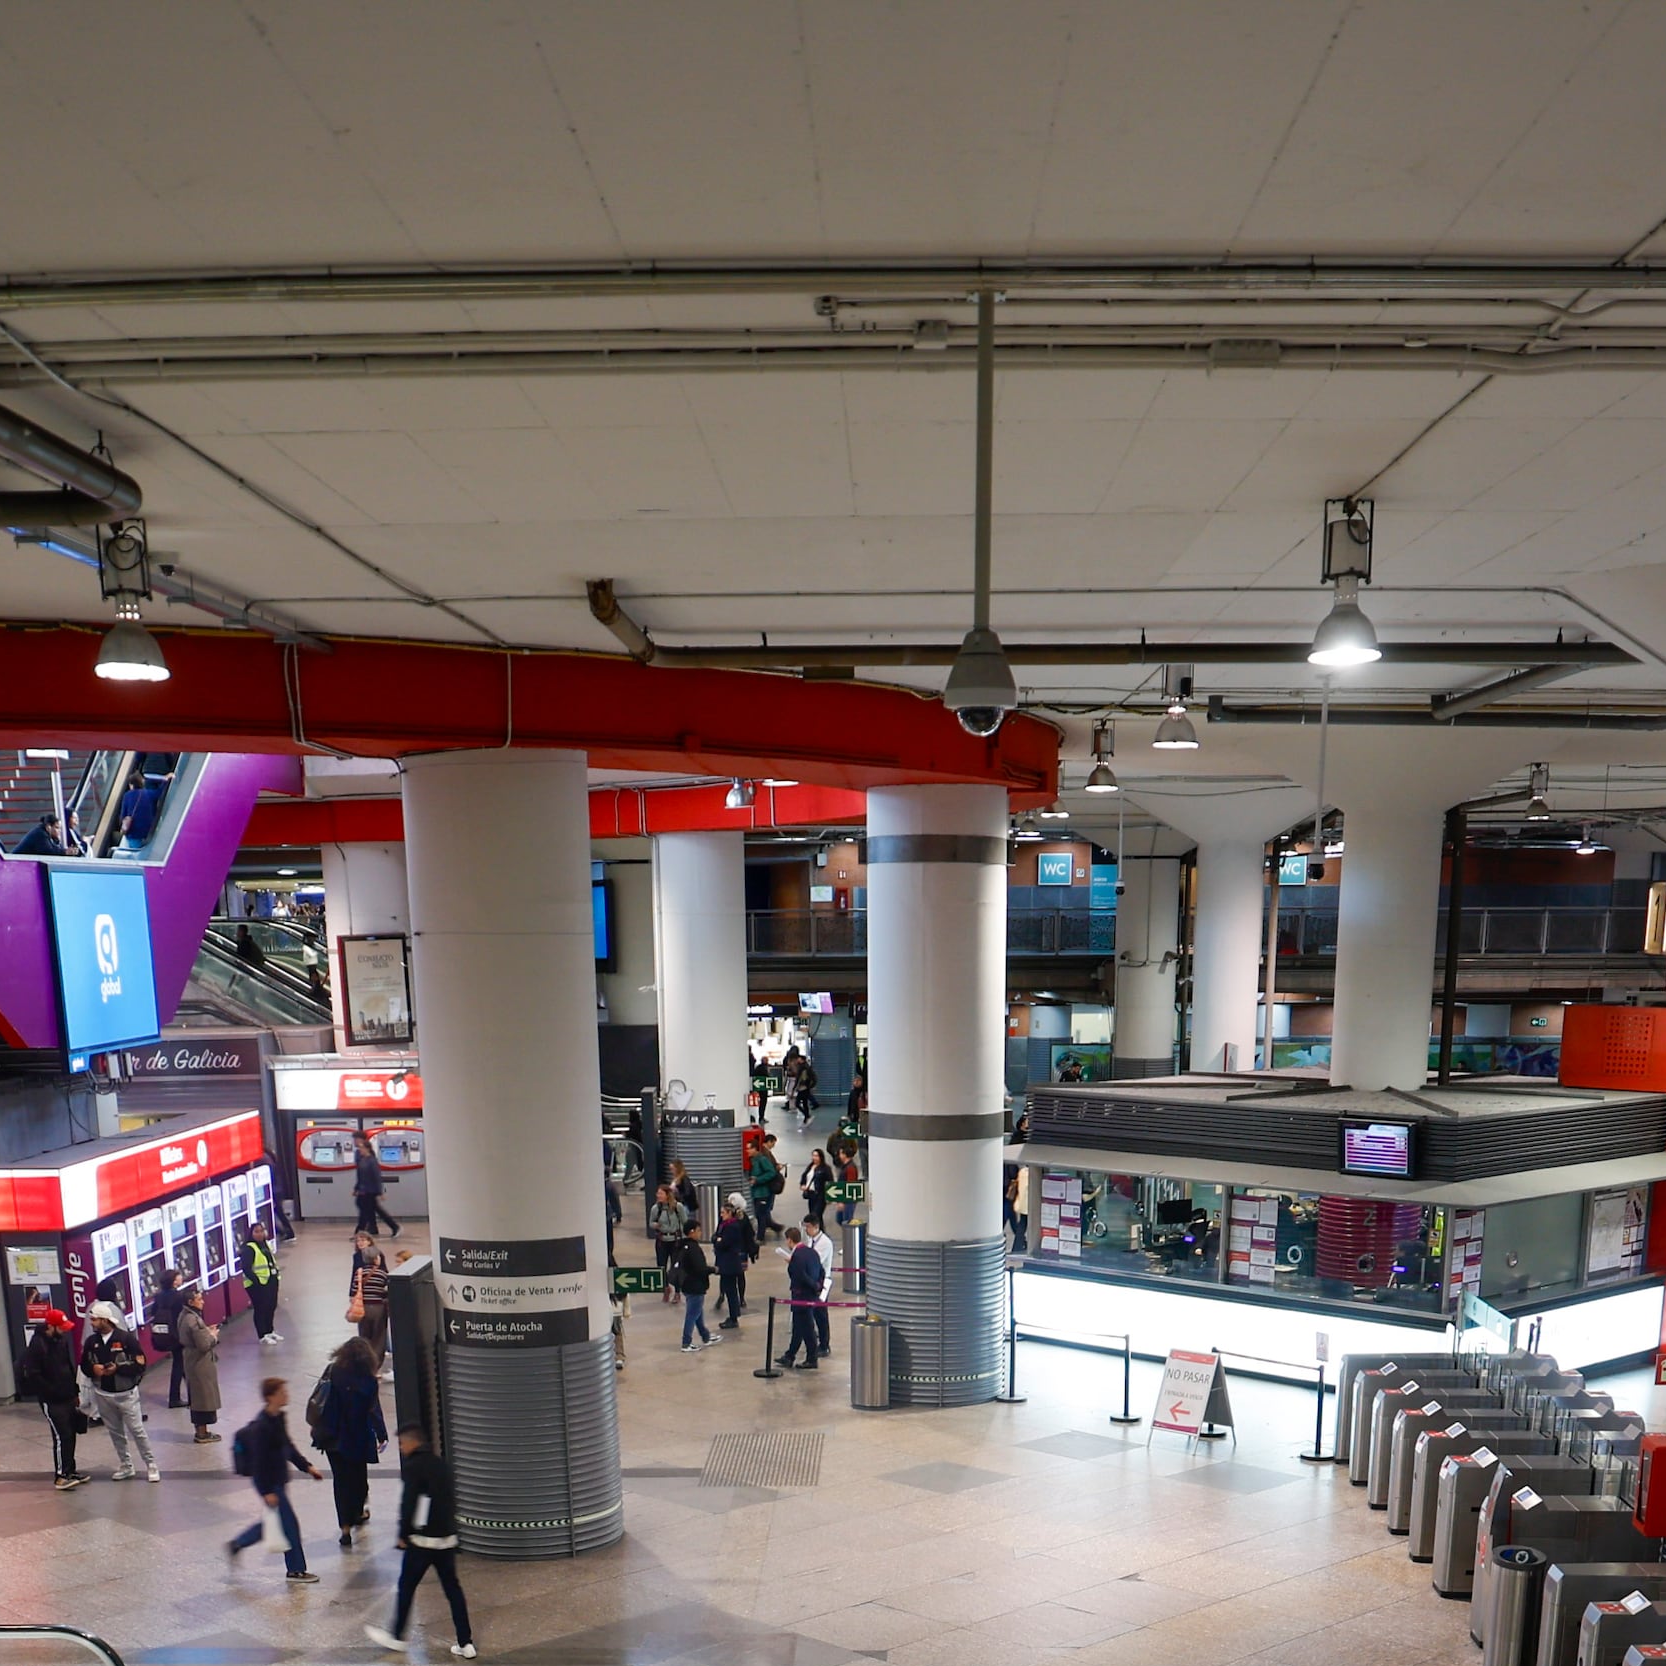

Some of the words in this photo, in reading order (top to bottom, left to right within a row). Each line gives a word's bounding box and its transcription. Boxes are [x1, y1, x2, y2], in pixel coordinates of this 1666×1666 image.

[1043, 862, 1067, 876] WC
[101, 977, 122, 1003] global
[146, 1050, 169, 1070] de
[174, 1049, 241, 1070] Galicia
[461, 1249, 509, 1261] Salida/Exit
[474, 1261, 493, 1269] Carlos
[64, 1252, 89, 1319] renfe
[480, 1286, 512, 1296] Oficina
[515, 1286, 526, 1295] de
[528, 1286, 554, 1296] Venta
[557, 1282, 583, 1295] renfe
[465, 1320, 493, 1332] Puerta
[495, 1321, 507, 1332] de
[509, 1321, 543, 1332] Atocha
[1166, 1367, 1180, 1380] NO
[1183, 1371, 1210, 1385] PASAR
